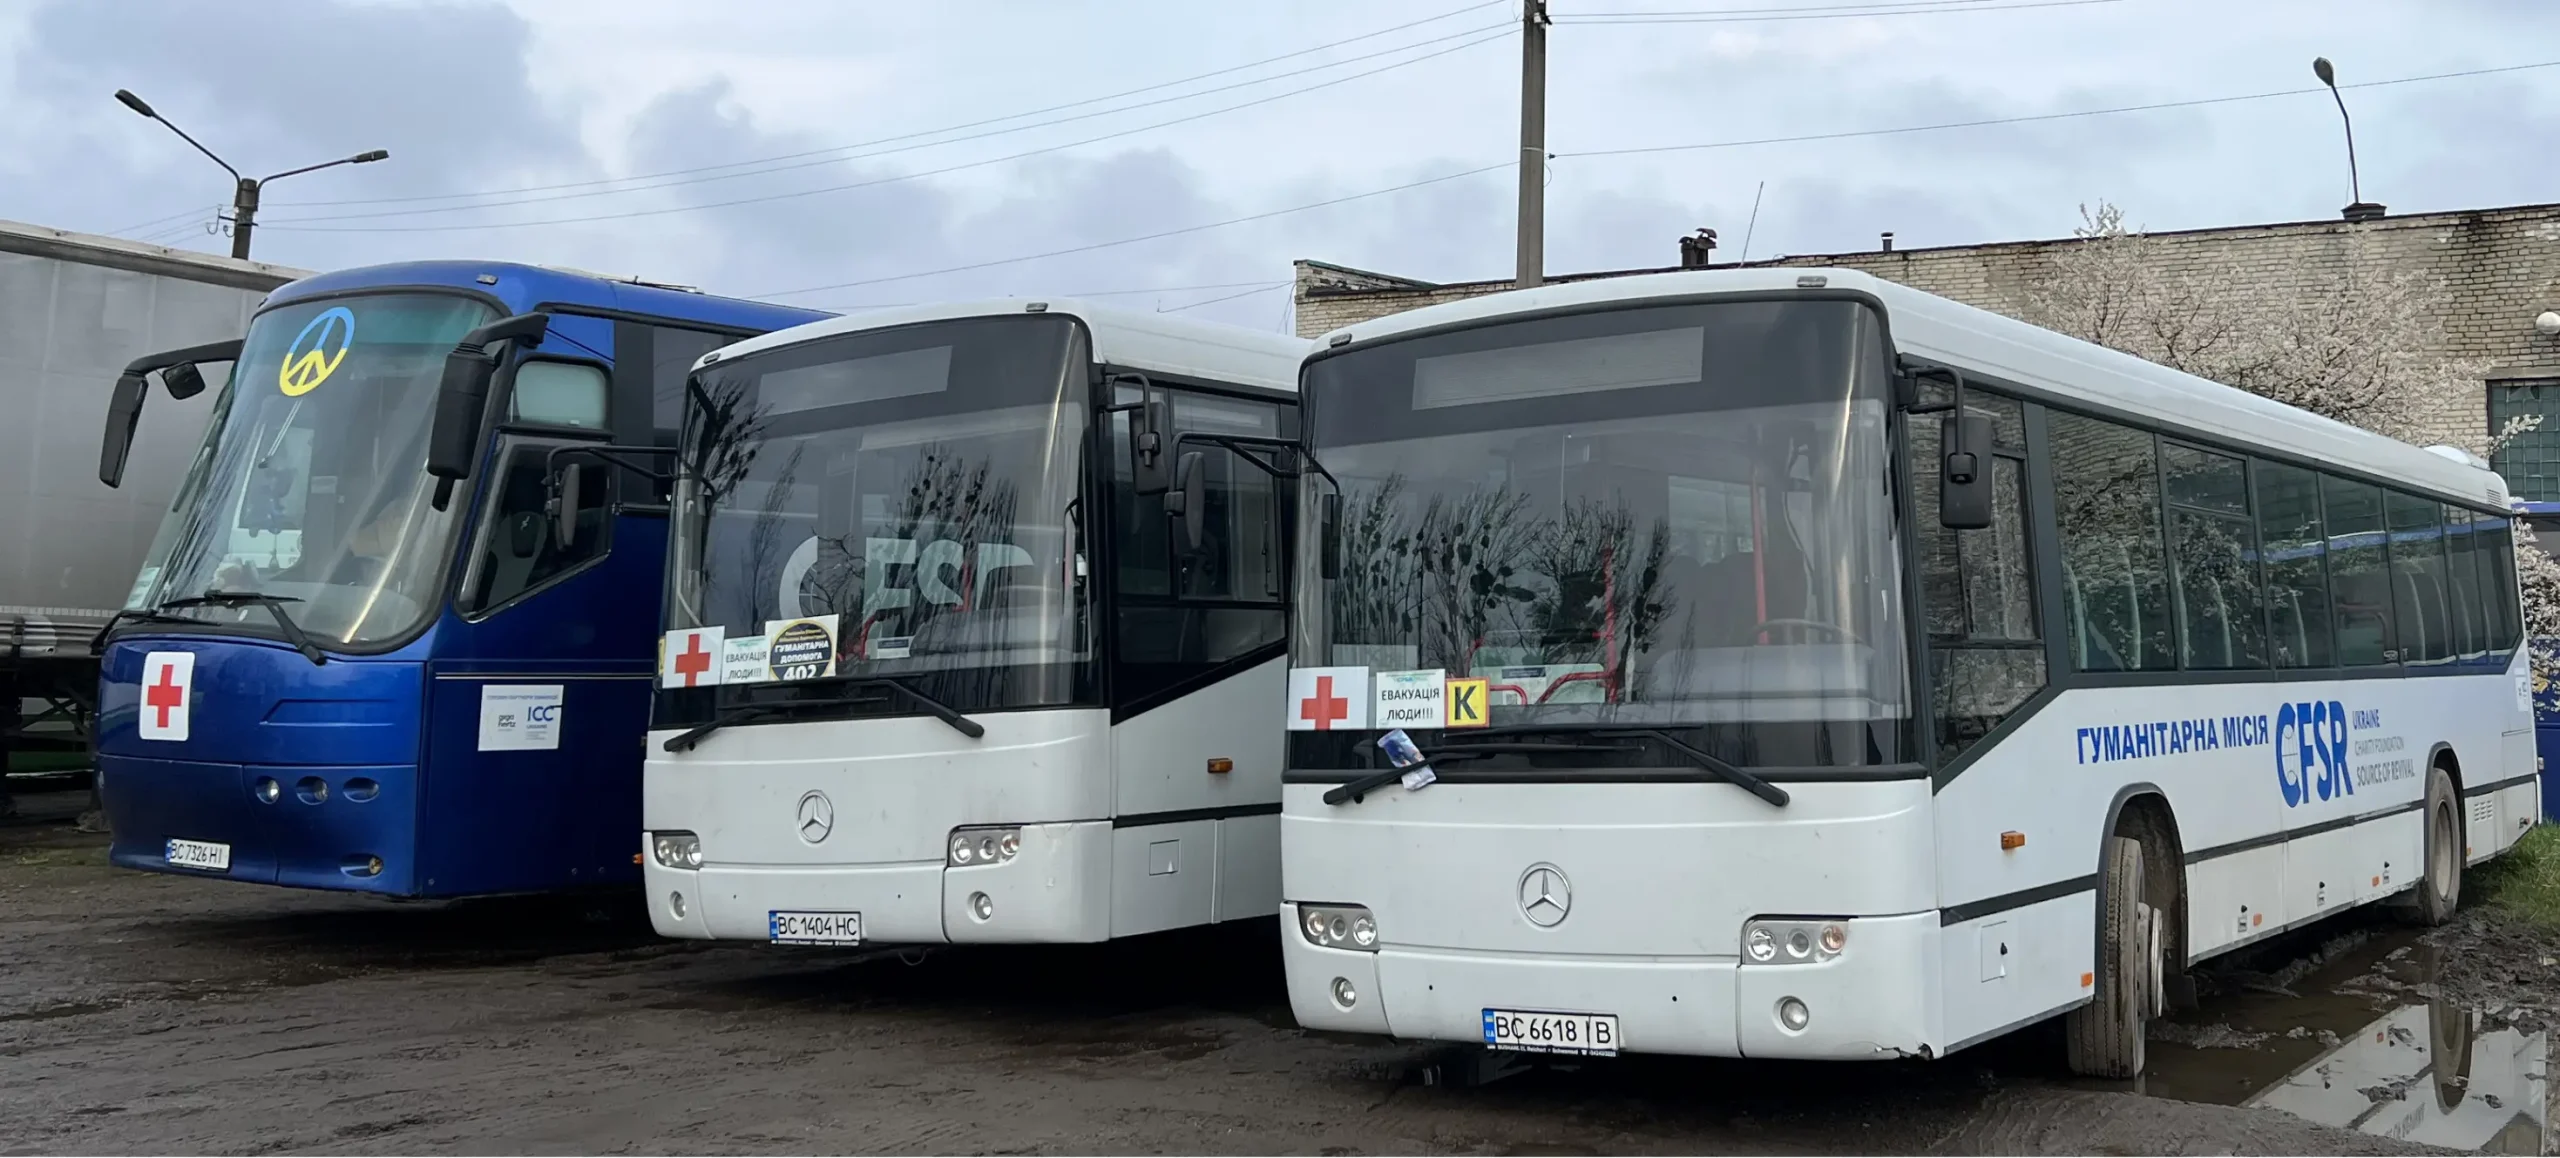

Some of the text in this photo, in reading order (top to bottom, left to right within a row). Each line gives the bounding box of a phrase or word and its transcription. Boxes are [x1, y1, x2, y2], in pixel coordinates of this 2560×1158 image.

[775, 640, 829, 653] ГУМАНІТАРНА
[726, 651, 767, 663] ЕВАКУАЦІЯ
[780, 652, 823, 664] ДОПОМОГА
[783, 664, 817, 681] 402
[1381, 688, 1440, 701] ЕВАКУАЦІЯ
[527, 706, 554, 722] ICC
[1387, 708, 1433, 722] ЛЮДИ!!!
[2352, 709, 2380, 730] UKRAINE
[2077, 715, 2269, 764] ГУМАНІТАРНА МІСІЯ
[2275, 700, 2354, 808] CFSR
[2357, 758, 2416, 787] SOURCE OF REVIVAL
[185, 844, 208, 862] 7326
[801, 917, 832, 936] 1404
[1530, 1018, 1577, 1042] 6618
